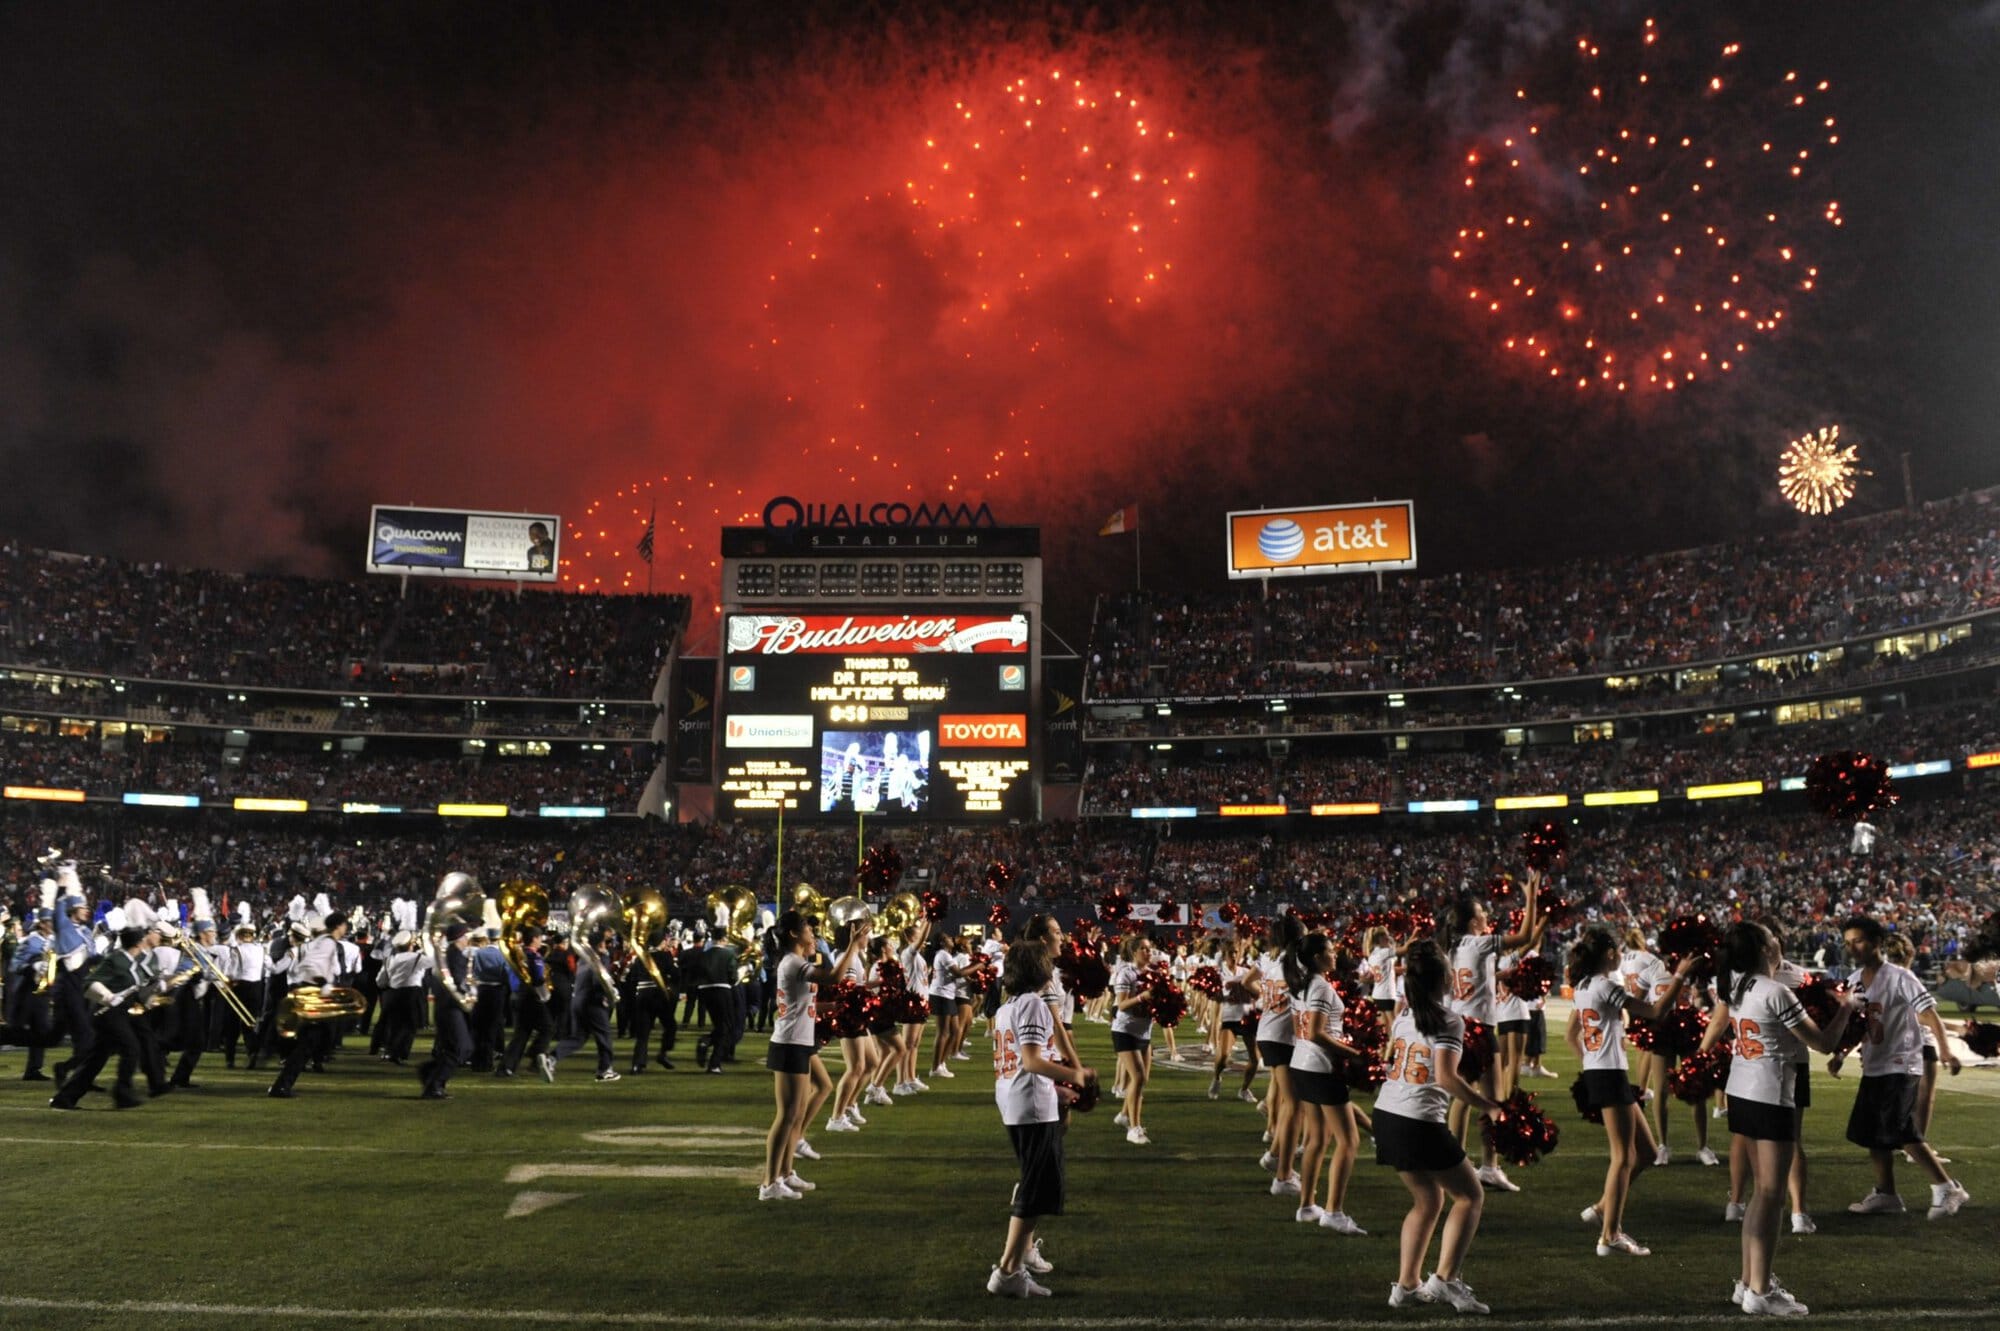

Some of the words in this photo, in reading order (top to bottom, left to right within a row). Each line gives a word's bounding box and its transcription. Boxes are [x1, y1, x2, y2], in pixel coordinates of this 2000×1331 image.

[763, 496, 998, 539] QUALCOMM
[379, 525, 462, 543] QUALCOMM
[811, 536, 978, 545] STADIUM
[1313, 518, 1388, 551] at&t
[757, 616, 956, 654] Budweiser
[844, 658, 889, 670] THANKS
[892, 658, 909, 670] TO
[833, 671, 855, 685] DR
[860, 671, 919, 685] PEPPER
[811, 687, 894, 700] HALFTIME
[902, 687, 946, 700] SHOW
[943, 723, 1022, 739] TOYOTA
